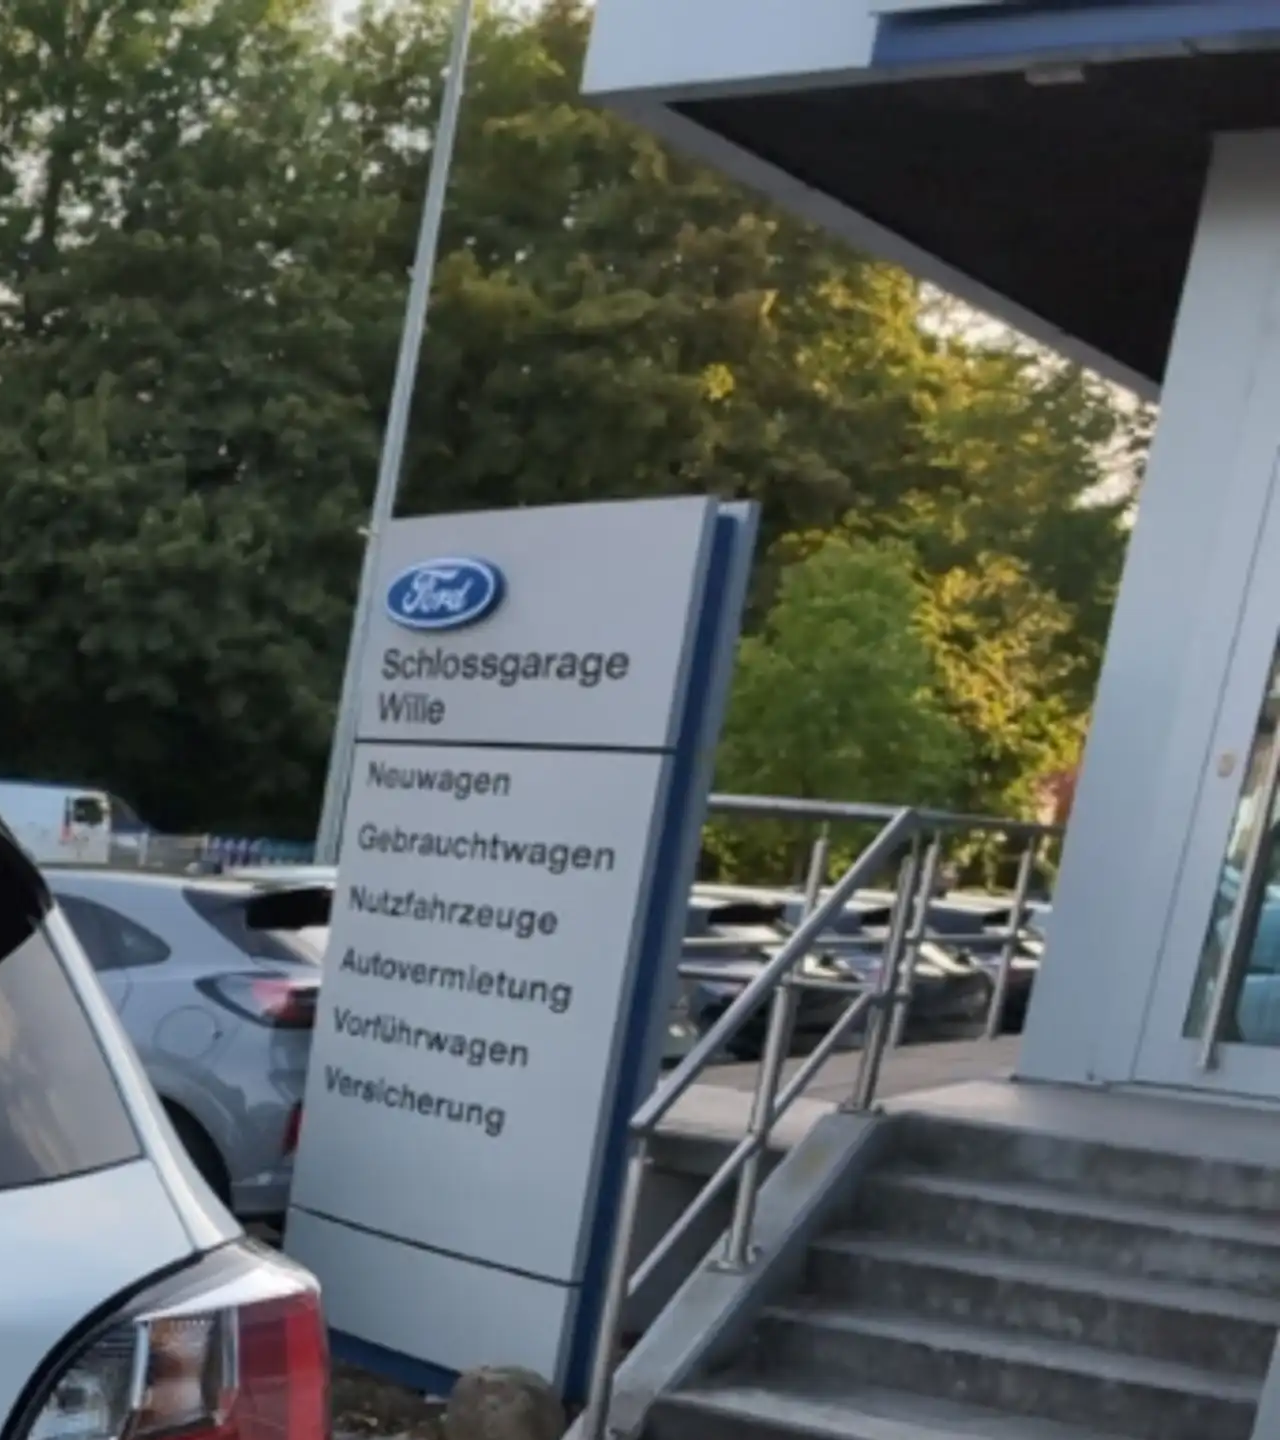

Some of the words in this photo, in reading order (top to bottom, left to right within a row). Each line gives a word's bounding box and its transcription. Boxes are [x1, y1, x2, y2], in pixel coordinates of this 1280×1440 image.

[381, 647, 630, 688] Schlossgarage
[378, 691, 446, 725] Wille
[367, 761, 511, 800] Neuwagen
[357, 821, 616, 875] Gebrauchtwagen
[348, 885, 558, 940] Nutzfahrzeuge
[339, 947, 573, 1014] Autovermietung
[333, 1005, 530, 1067] Vorführwagen
[324, 1065, 506, 1137] Versicherung
